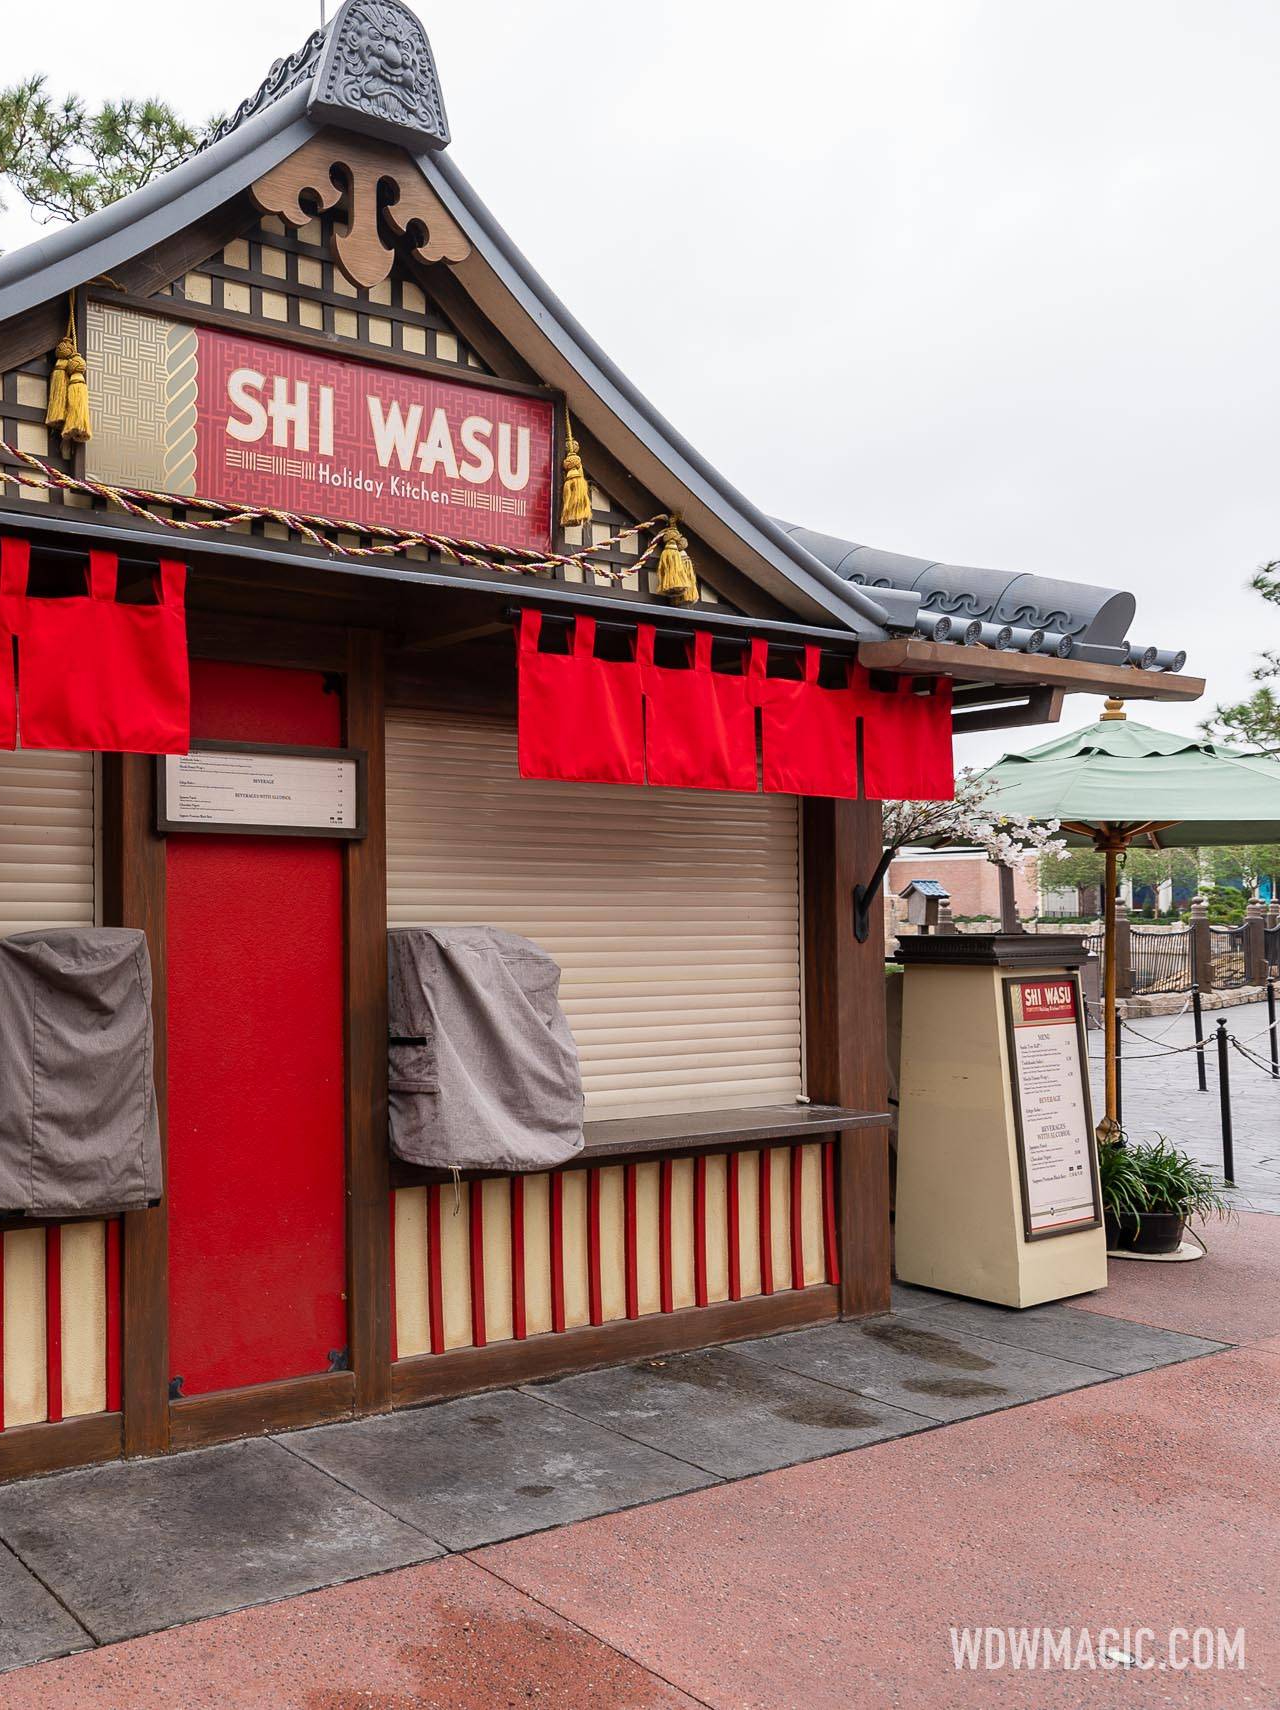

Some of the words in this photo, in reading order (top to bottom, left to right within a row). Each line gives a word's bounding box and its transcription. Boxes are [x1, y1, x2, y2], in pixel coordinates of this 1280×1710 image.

[225, 367, 335, 456] SHI
[366, 394, 531, 491] WASU
[319, 463, 384, 498] Holiday
[390, 475, 450, 505] Kitchen
[1025, 988, 1042, 1006] SHI
[1044, 986, 1071, 1005] WASU
